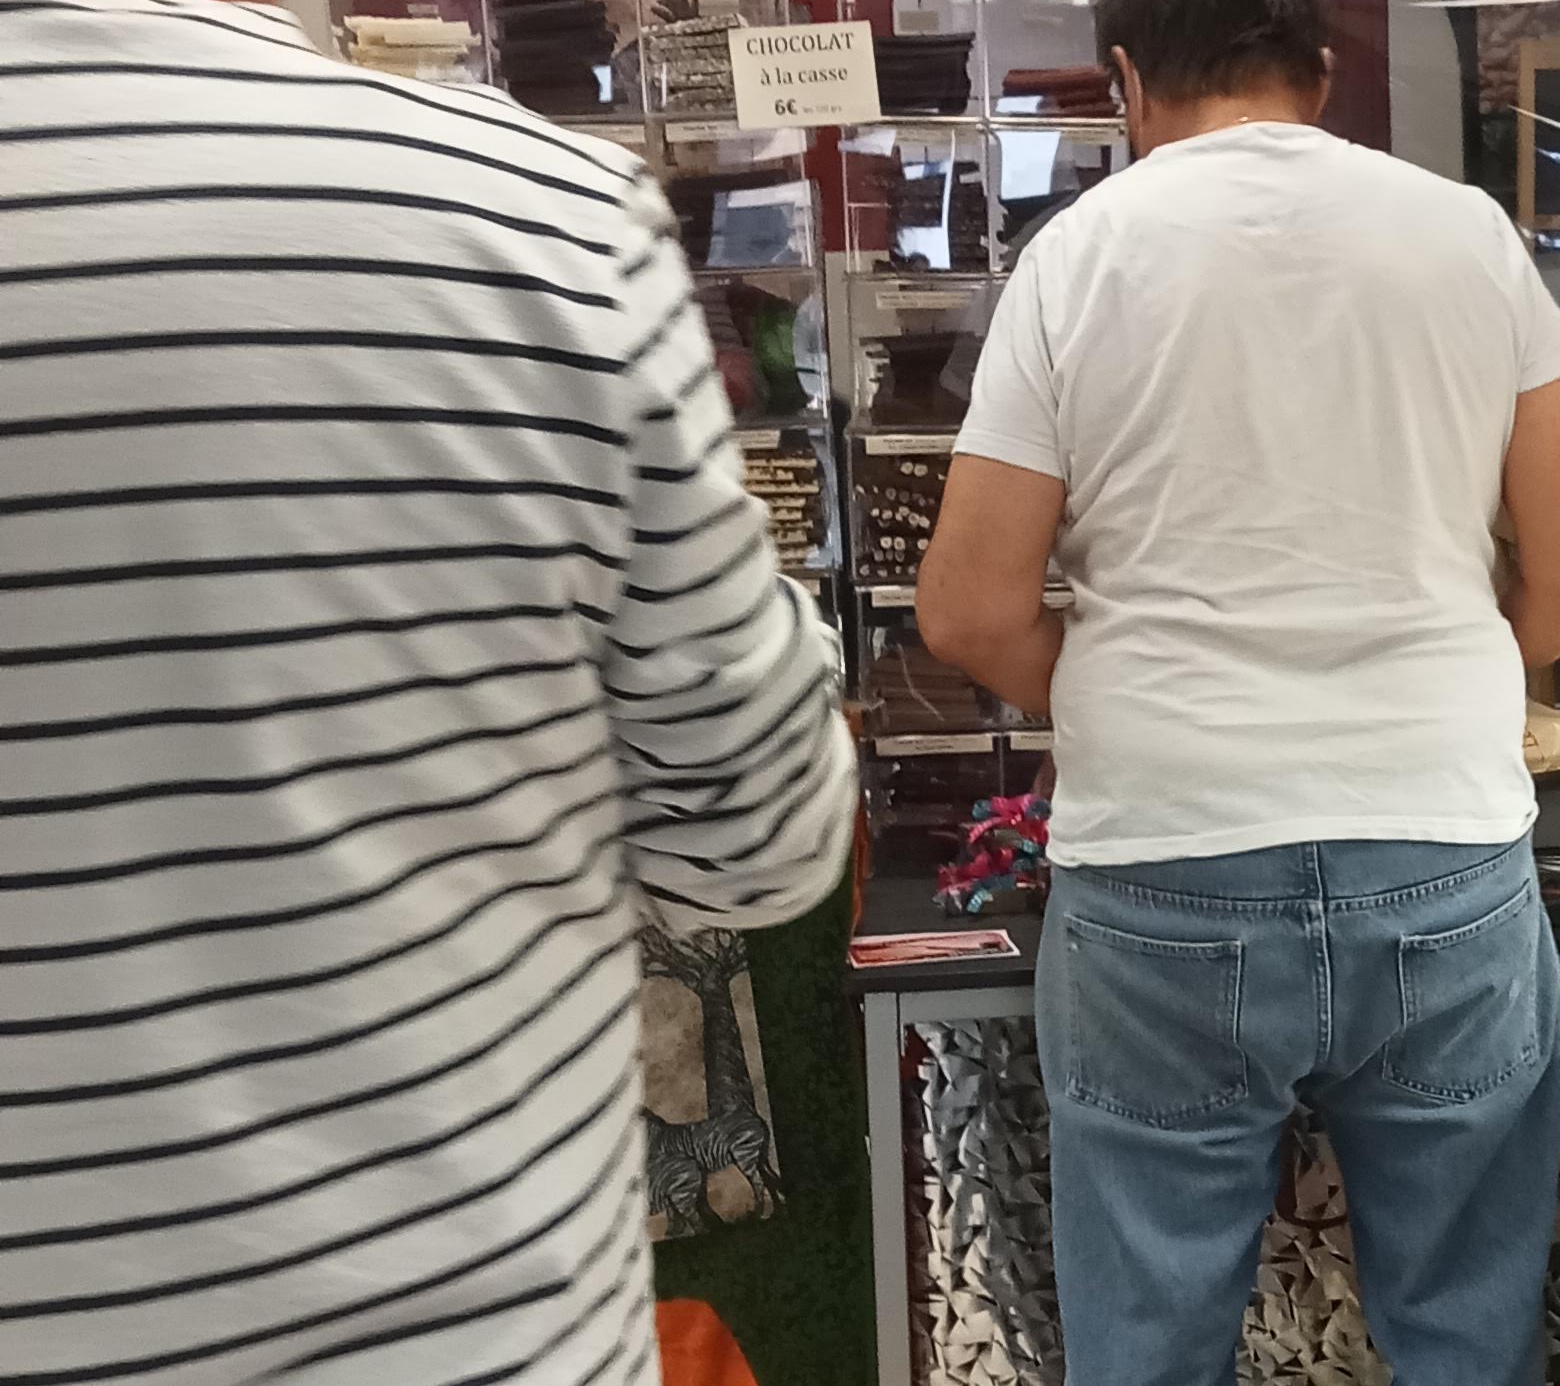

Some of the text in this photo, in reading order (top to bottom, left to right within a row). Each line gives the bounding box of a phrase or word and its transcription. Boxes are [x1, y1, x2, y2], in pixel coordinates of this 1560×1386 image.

[746, 32, 855, 56] CHOCOLAT
[760, 68, 848, 86] à la casse
[774, 99, 798, 116] 6€
